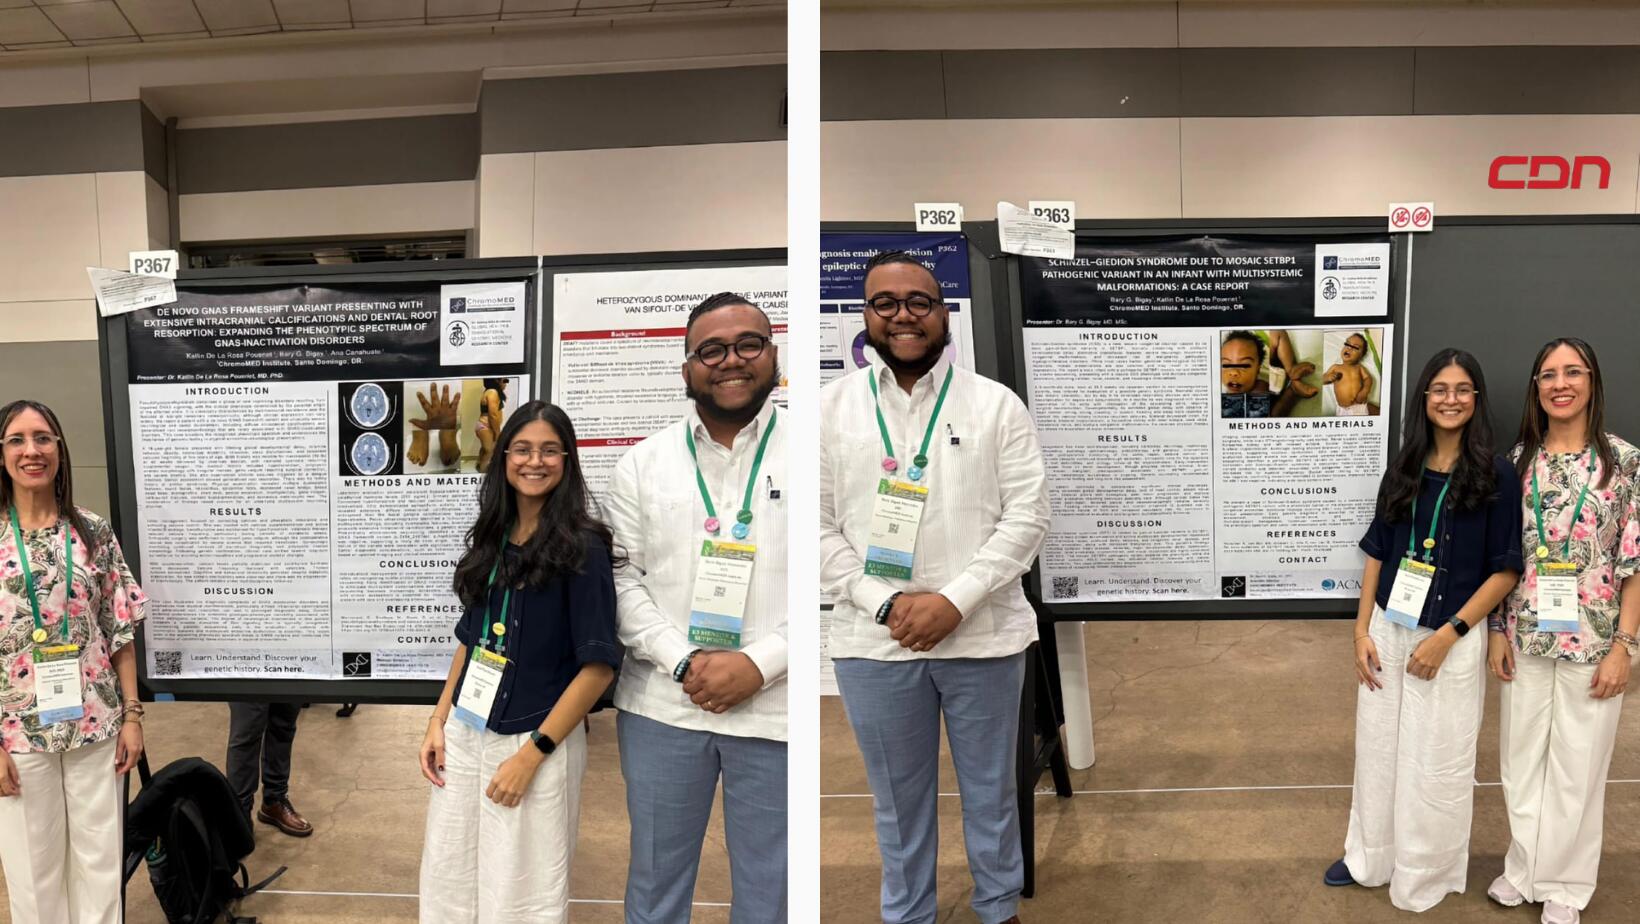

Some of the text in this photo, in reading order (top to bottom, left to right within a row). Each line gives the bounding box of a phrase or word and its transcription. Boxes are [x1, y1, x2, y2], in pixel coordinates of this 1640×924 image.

[919, 210, 957, 225] P362
[1033, 207, 1071, 223] P363
[134, 257, 172, 274] P367
[1136, 257, 1188, 266] SYNDROME
[1190, 256, 1209, 266] DUE
[1211, 256, 1224, 266] TO
[1225, 256, 1262, 266] MOSAIC
[1263, 256, 1296, 265] SETBP1
[822, 261, 862, 272] epileptic
[1042, 268, 1304, 279] PATHOGENIC VARIANT IN AN INFANT WITH MULTISYSTEMIC
[1096, 281, 1250, 292] MALFORMATIONS: A CASE REPORT
[596, 295, 663, 305] HETEROZYGOUS
[664, 293, 708, 303] DOMINANT
[753, 290, 788, 299] VARIANT
[156, 300, 424, 317] DE NOVO GNAS FRAMESHIFT VARIANT PRESENTING WITH
[624, 306, 641, 314] VAN
[642, 304, 687, 314] SIFOUT-DE
[143, 311, 439, 328] EXTENSIVE INTRACRANIAL CALCIFICATIONS AND DENTAL ROOT
[154, 322, 429, 339] RESORPTION: EXPANDING THE PHENOTYPIC SPECTRUM OF
[610, 330, 647, 338] Background
[214, 335, 366, 348] GNAS-INACTIVATION DISORDERS
[1079, 333, 1159, 341] INTRODUCTION
[294, 358, 316, 367] Santo
[185, 386, 270, 396] INTRODUCTION
[1228, 420, 1375, 431] METHODS AND MATERIALS
[606, 438, 629, 446] Clinical
[1097, 435, 1149, 443] RESULTS
[344, 478, 402, 488] METHODS
[406, 477, 432, 487] AND
[1260, 486, 1338, 496] CONCLUSIONS
[209, 507, 262, 516] RESULTS
[1096, 520, 1163, 528] DISCUSSION
[1266, 530, 1337, 538] REFERENCES
[1278, 556, 1329, 564] CONTACT
[1083, 576, 1202, 586] Learn. Understand. Discover your
[203, 587, 275, 596] DISCUSSION
[1097, 586, 1190, 597] genetic history. Scan here.
[386, 605, 465, 613] REFERENCES
[397, 636, 453, 644] CONTACT
[190, 653, 318, 664] Learn. Understand. Discover your
[204, 664, 305, 675] genetic history. Scan here.
